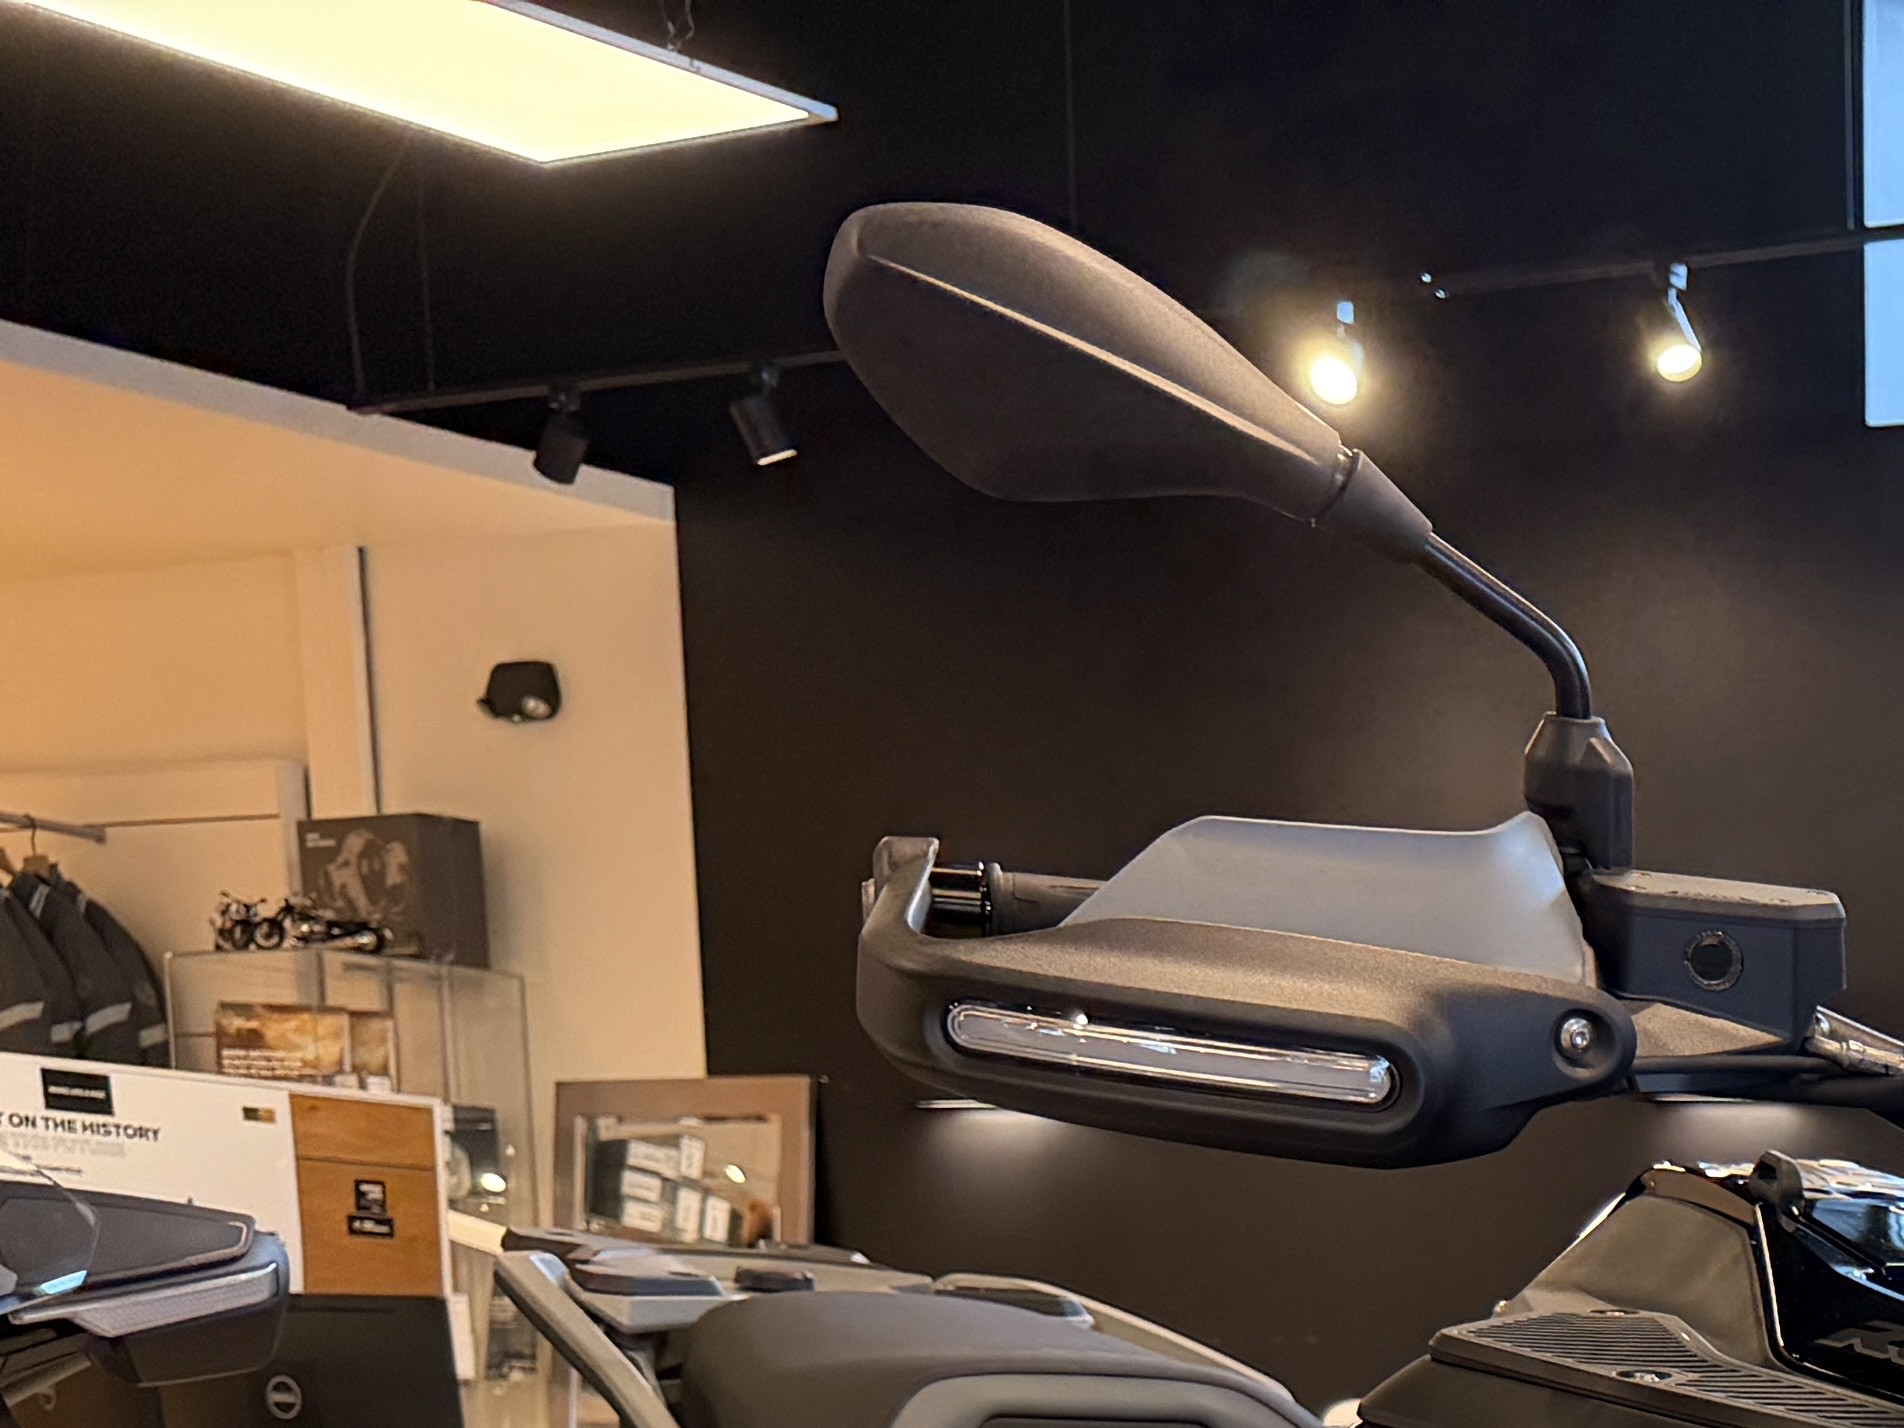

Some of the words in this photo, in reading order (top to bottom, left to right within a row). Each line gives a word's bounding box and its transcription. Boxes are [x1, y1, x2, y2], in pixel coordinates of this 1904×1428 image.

[8, 1112, 37, 1129] ON
[40, 1116, 77, 1134] THE
[81, 1119, 161, 1142] HISTORY
